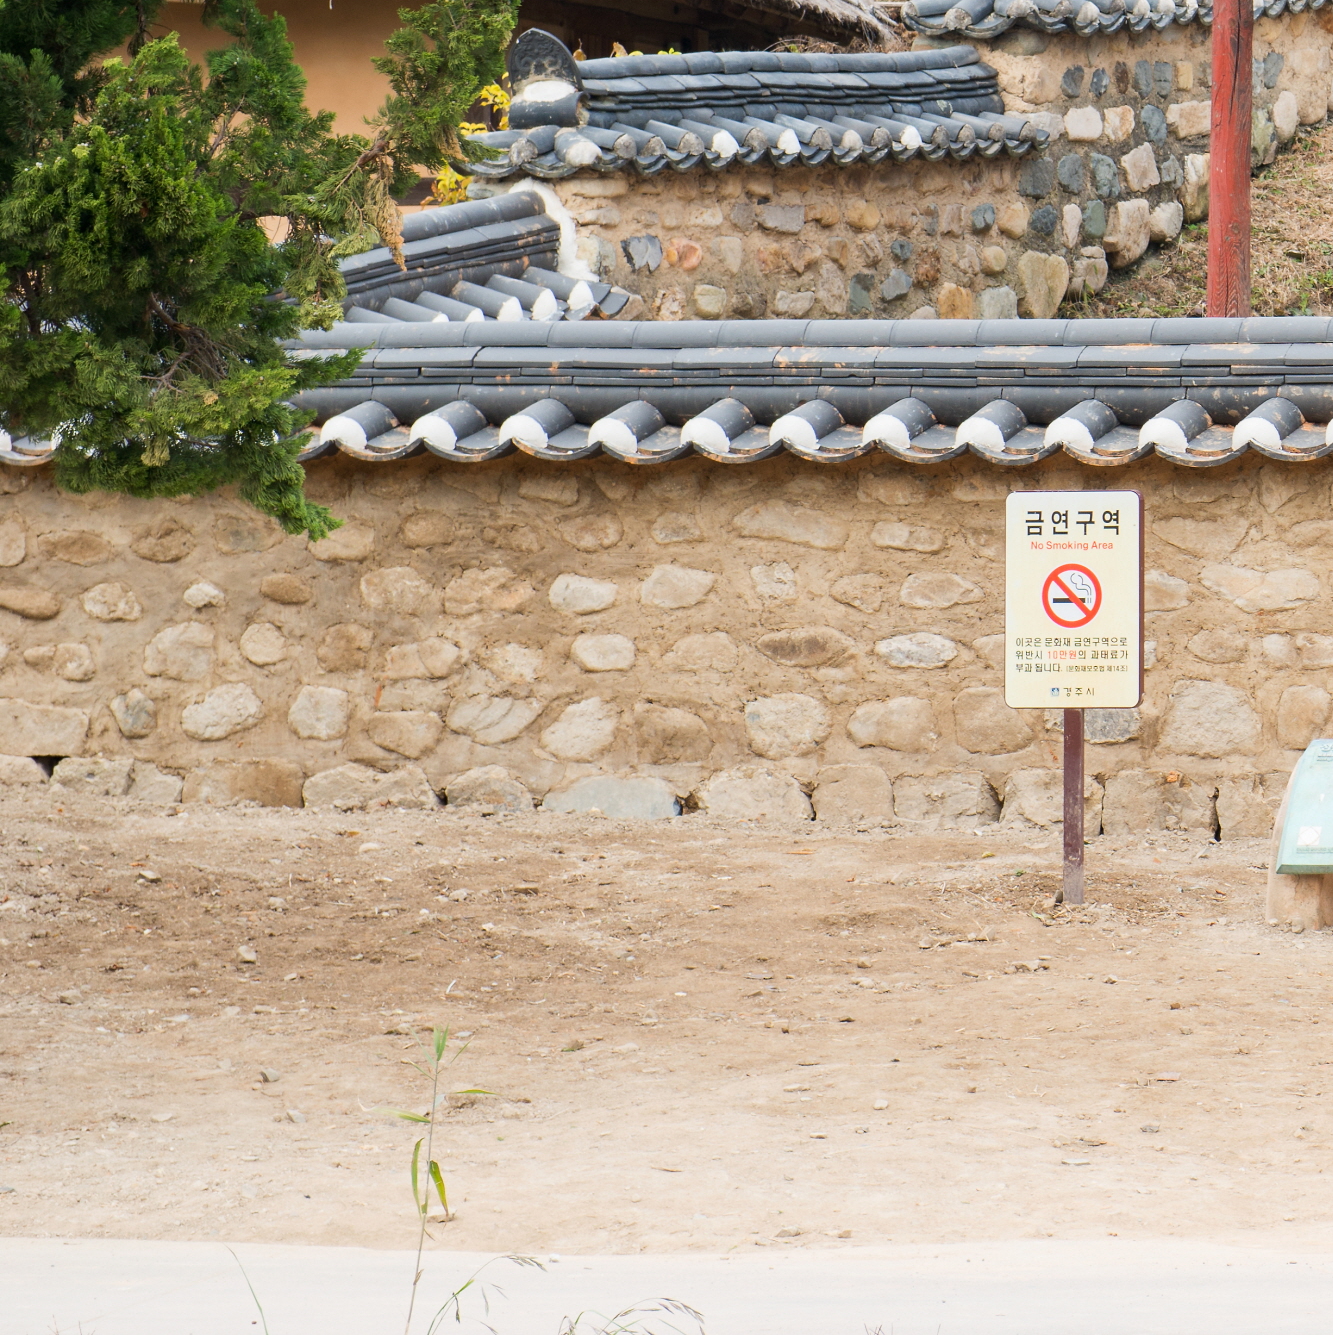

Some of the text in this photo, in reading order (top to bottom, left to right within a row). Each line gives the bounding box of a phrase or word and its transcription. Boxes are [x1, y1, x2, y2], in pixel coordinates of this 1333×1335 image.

[1025, 510, 1120, 536] 금연구역
[1031, 541, 1114, 551] No Smoking Area
[1015, 638, 1127, 647] 이곳은 문화재 금연구역으로
[1015, 650, 1043, 660] 위반시
[1091, 650, 1128, 660] 과태료가
